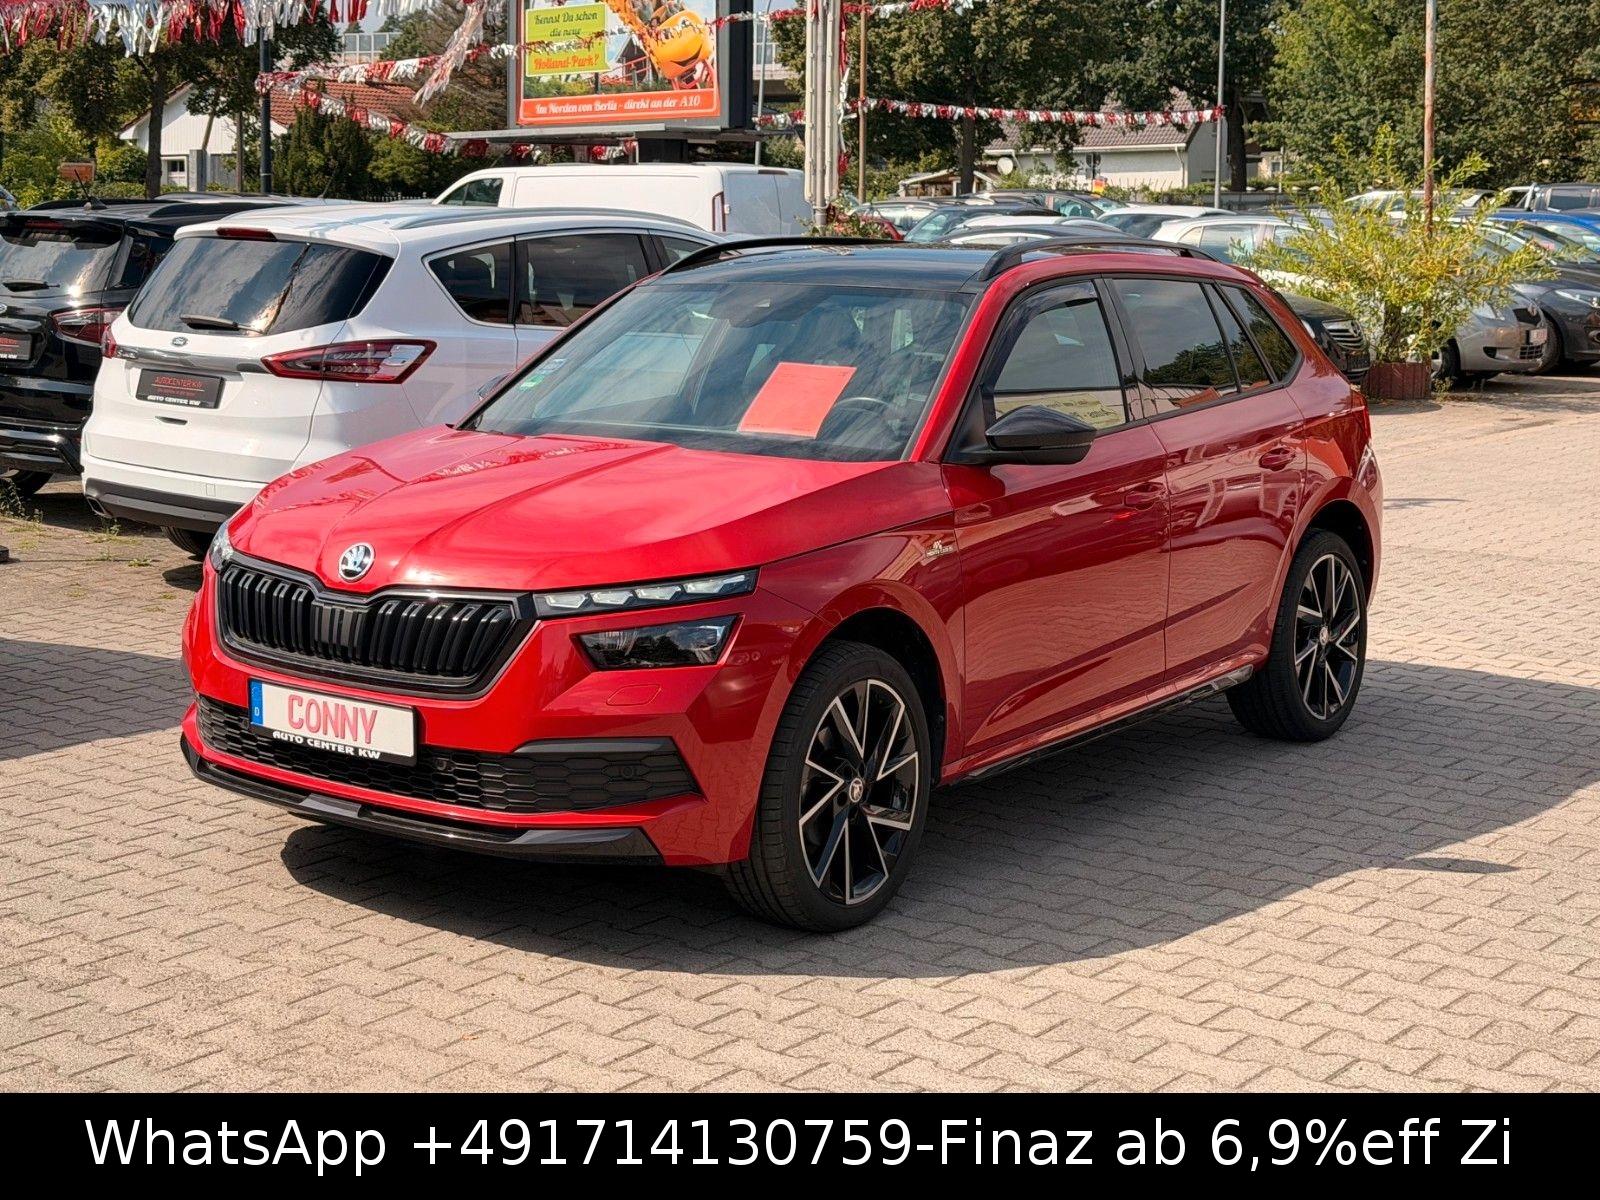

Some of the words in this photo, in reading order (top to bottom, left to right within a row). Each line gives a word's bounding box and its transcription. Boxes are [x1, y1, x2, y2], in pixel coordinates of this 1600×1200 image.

[550, 28, 561, 37] die
[549, 103, 577, 114] Norden
[681, 95, 700, 107] A10
[254, 706, 260, 717] D
[287, 694, 378, 745] CONNY
[272, 731, 304, 744] AUTO
[307, 739, 355, 756] CENTER
[358, 748, 381, 760] KW
